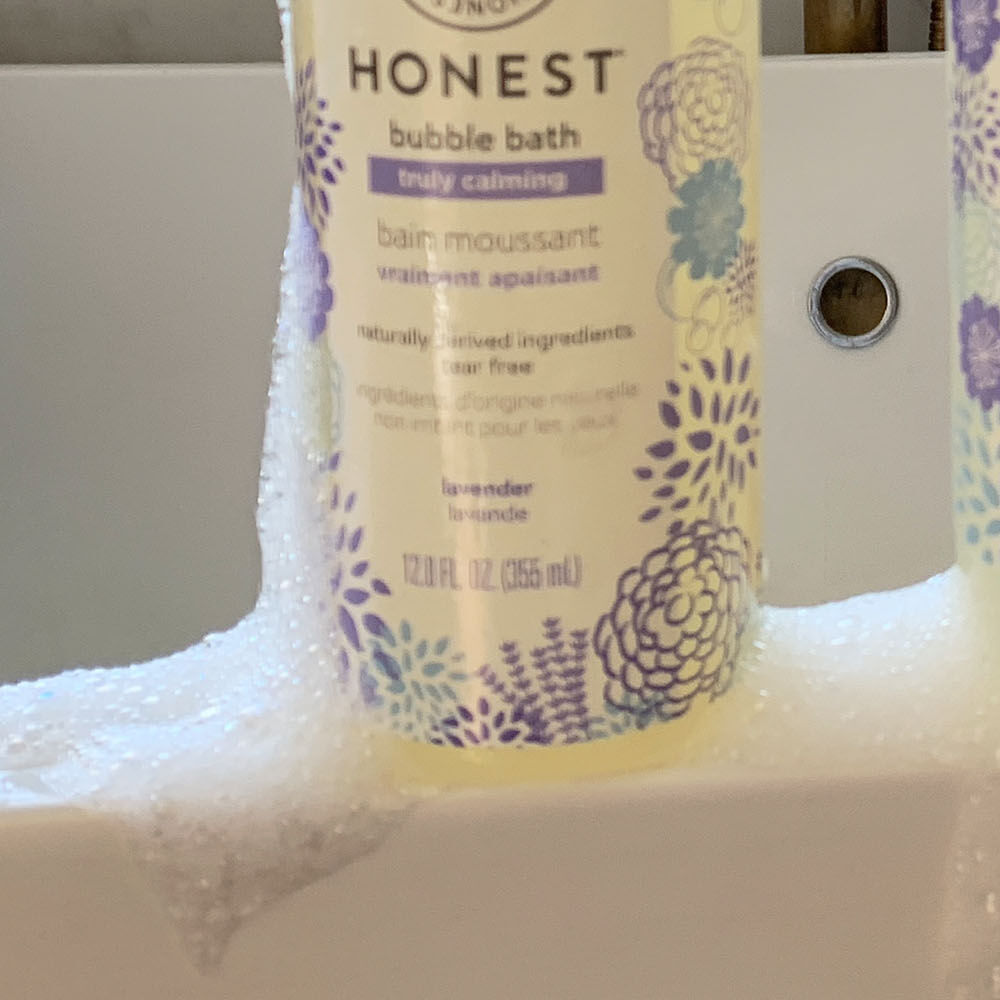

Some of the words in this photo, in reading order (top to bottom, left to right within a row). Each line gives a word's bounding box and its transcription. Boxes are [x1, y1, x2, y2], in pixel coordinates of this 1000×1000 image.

[348, 46, 616, 98] HONEST
[388, 119, 495, 151] bubble
[504, 120, 582, 151] bath
[398, 167, 456, 193] truly
[461, 169, 569, 193] calming
[377, 218, 435, 249] bain
[445, 224, 601, 253] moussant
[489, 263, 601, 290] apaisant
[517, 324, 636, 353] ingredients
[488, 357, 535, 375] free
[441, 476, 535, 497] lavender
[448, 503, 529, 522] lavande
